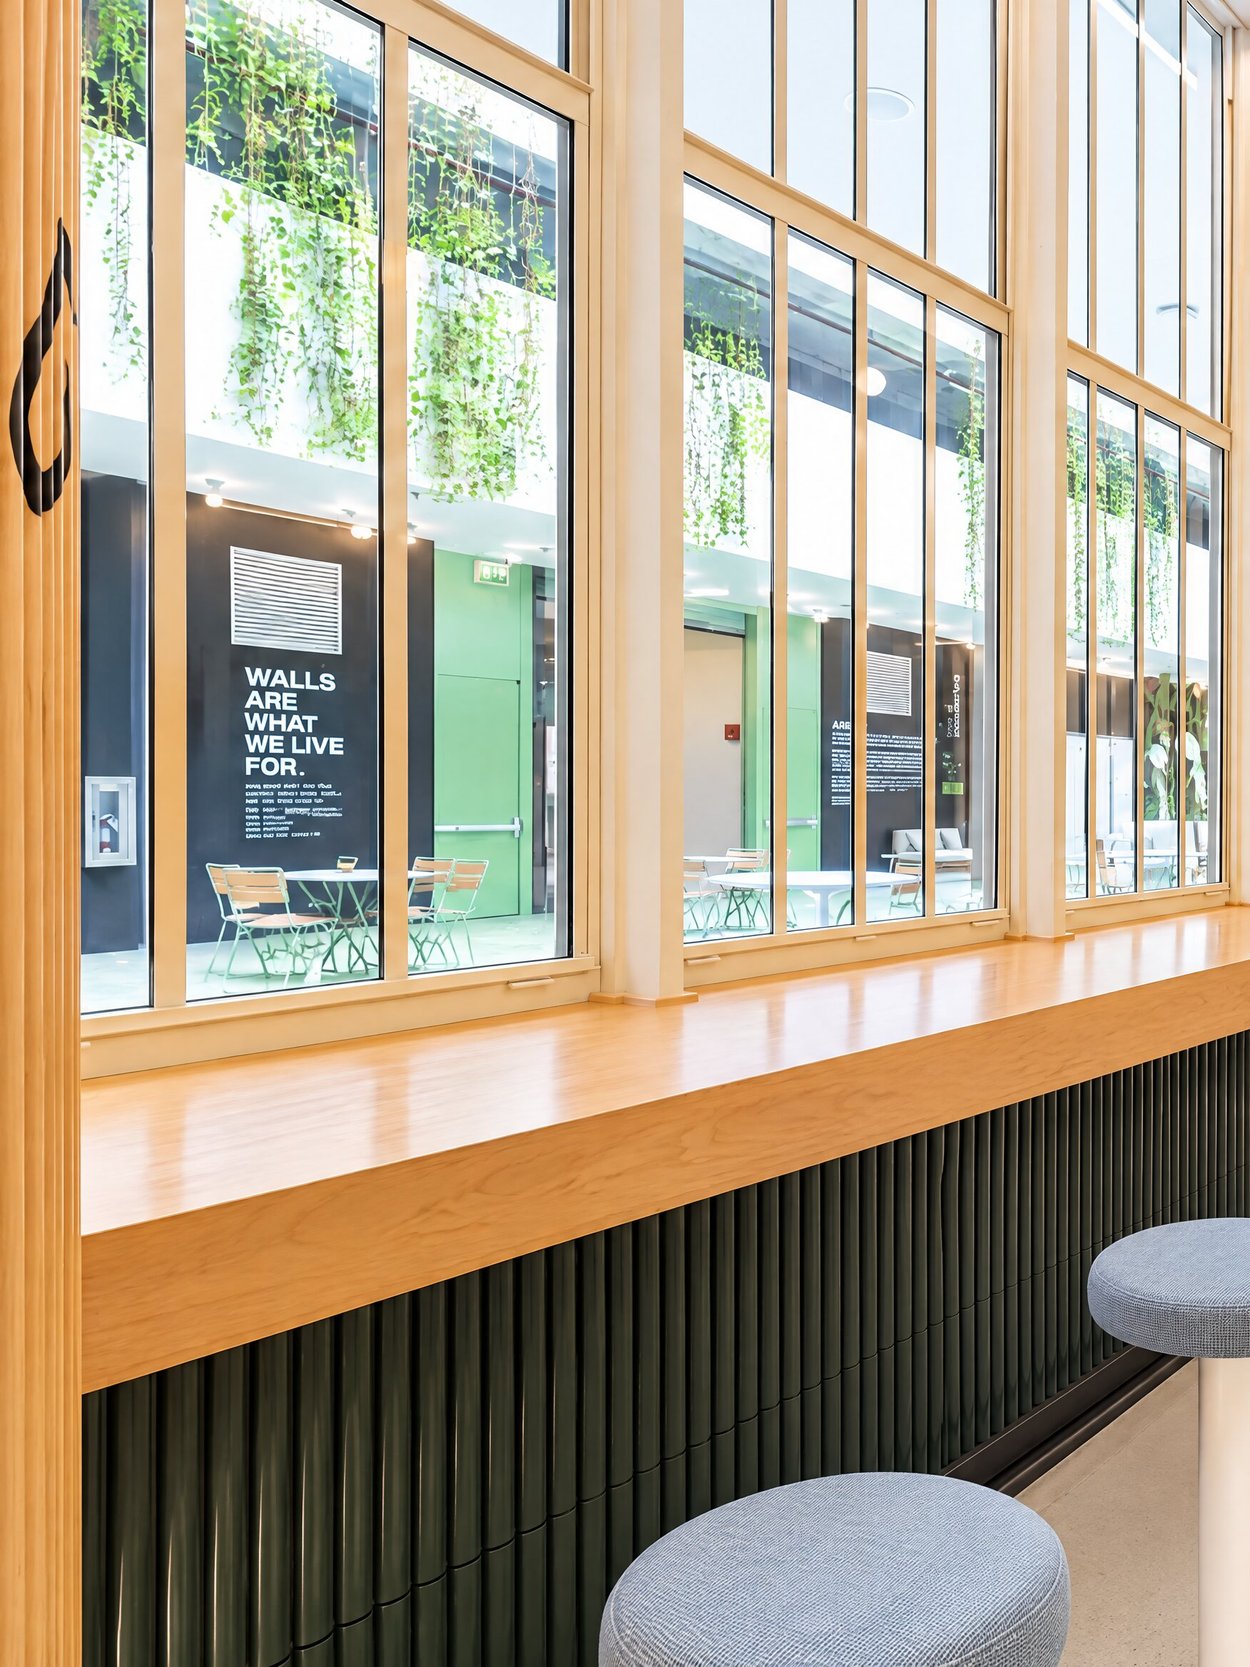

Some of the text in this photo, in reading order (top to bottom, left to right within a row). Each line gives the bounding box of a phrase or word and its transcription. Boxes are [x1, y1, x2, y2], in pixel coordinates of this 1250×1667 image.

[244, 666, 337, 692] WALLS
[244, 690, 298, 712] ARE
[244, 711, 319, 733] WHAT
[244, 734, 345, 756] WE LIVE
[245, 757, 305, 777] FOR.
